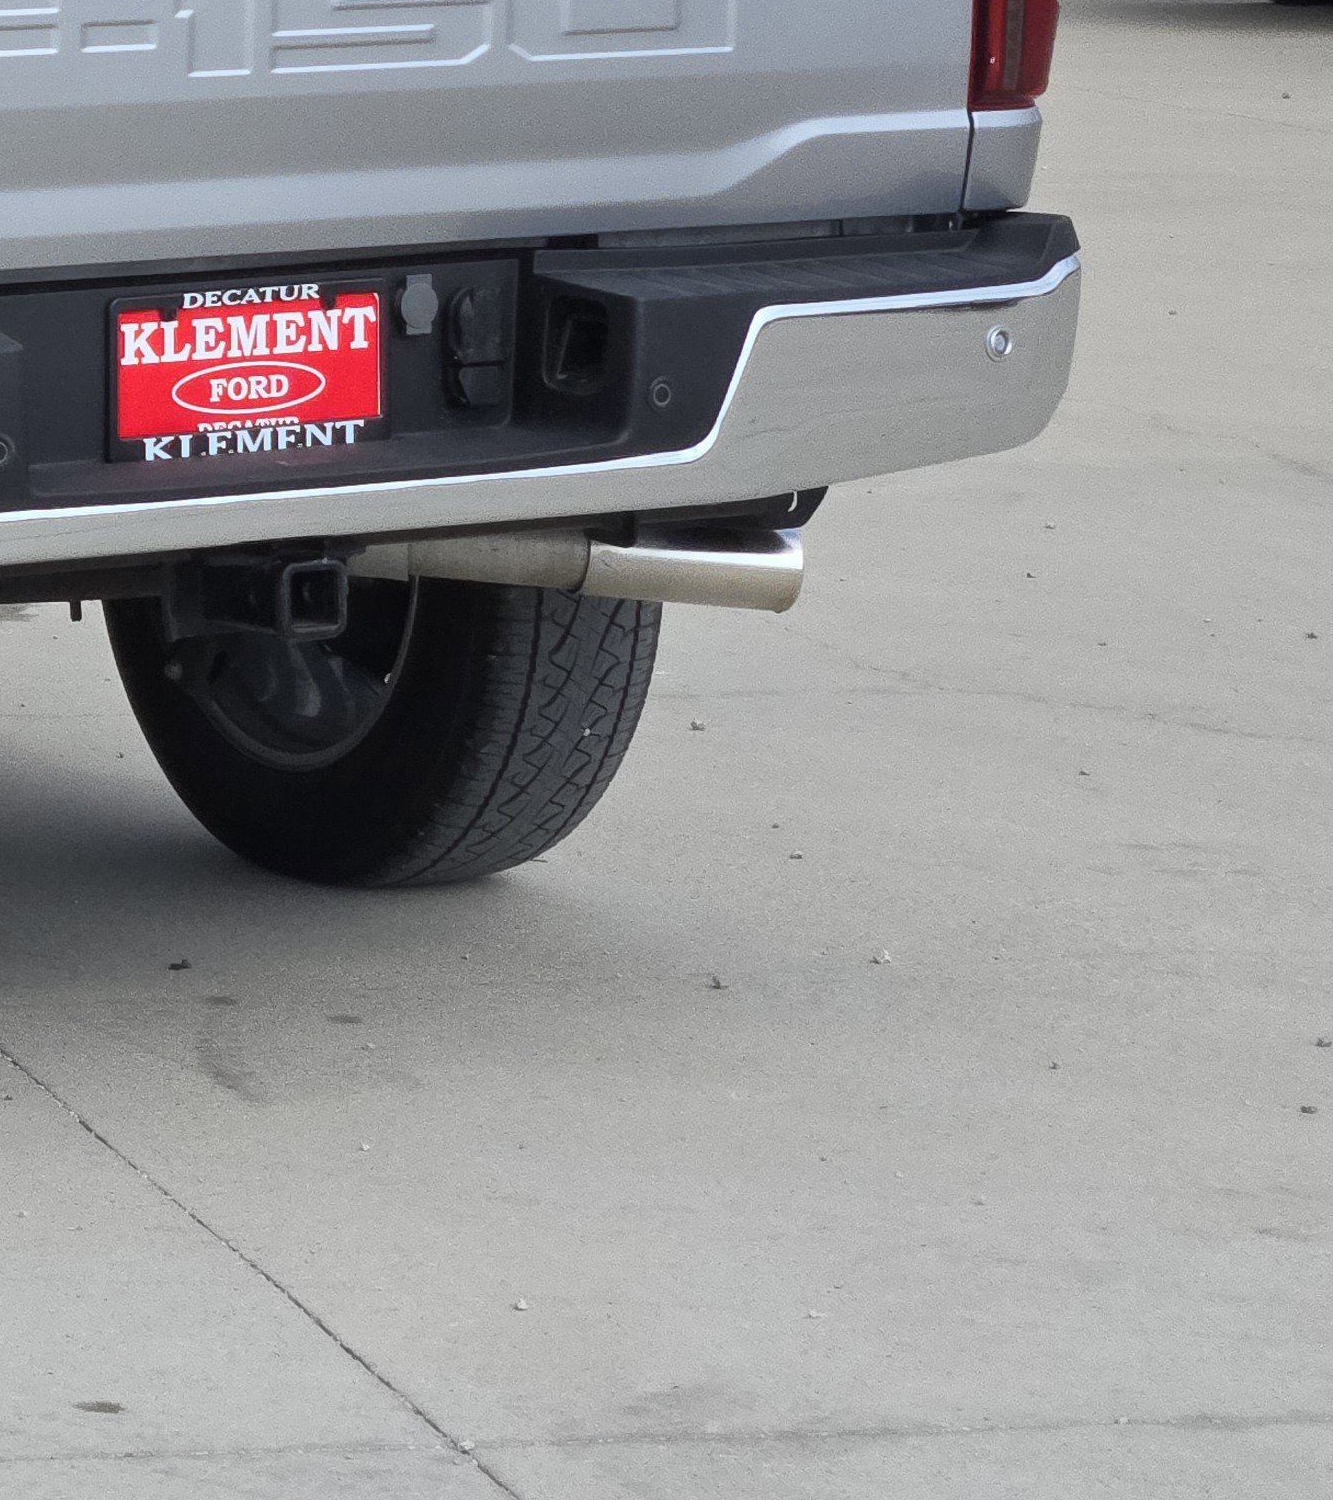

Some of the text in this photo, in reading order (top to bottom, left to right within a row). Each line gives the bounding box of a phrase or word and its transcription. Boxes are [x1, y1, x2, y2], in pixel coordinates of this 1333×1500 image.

[182, 283, 321, 310] DECATUR
[119, 305, 378, 366] KLEMENT
[209, 374, 290, 403] FORD
